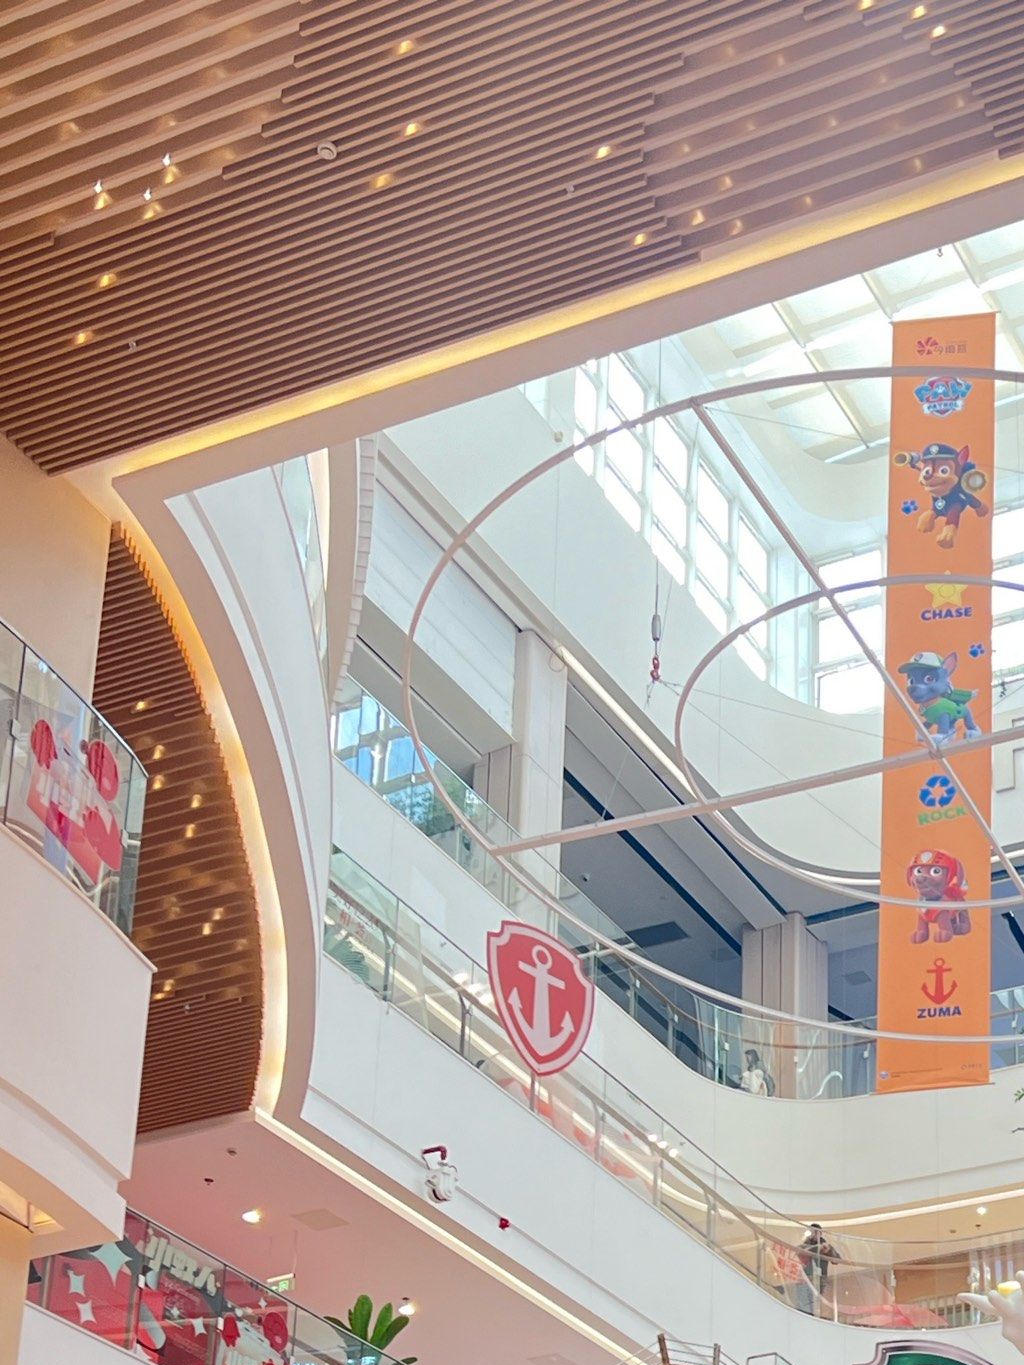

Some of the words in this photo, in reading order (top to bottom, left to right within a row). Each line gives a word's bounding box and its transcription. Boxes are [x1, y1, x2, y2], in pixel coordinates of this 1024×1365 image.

[920, 606, 972, 621] CHASE
[918, 806, 967, 826] ROCK
[917, 1005, 962, 1019] ZUMA
